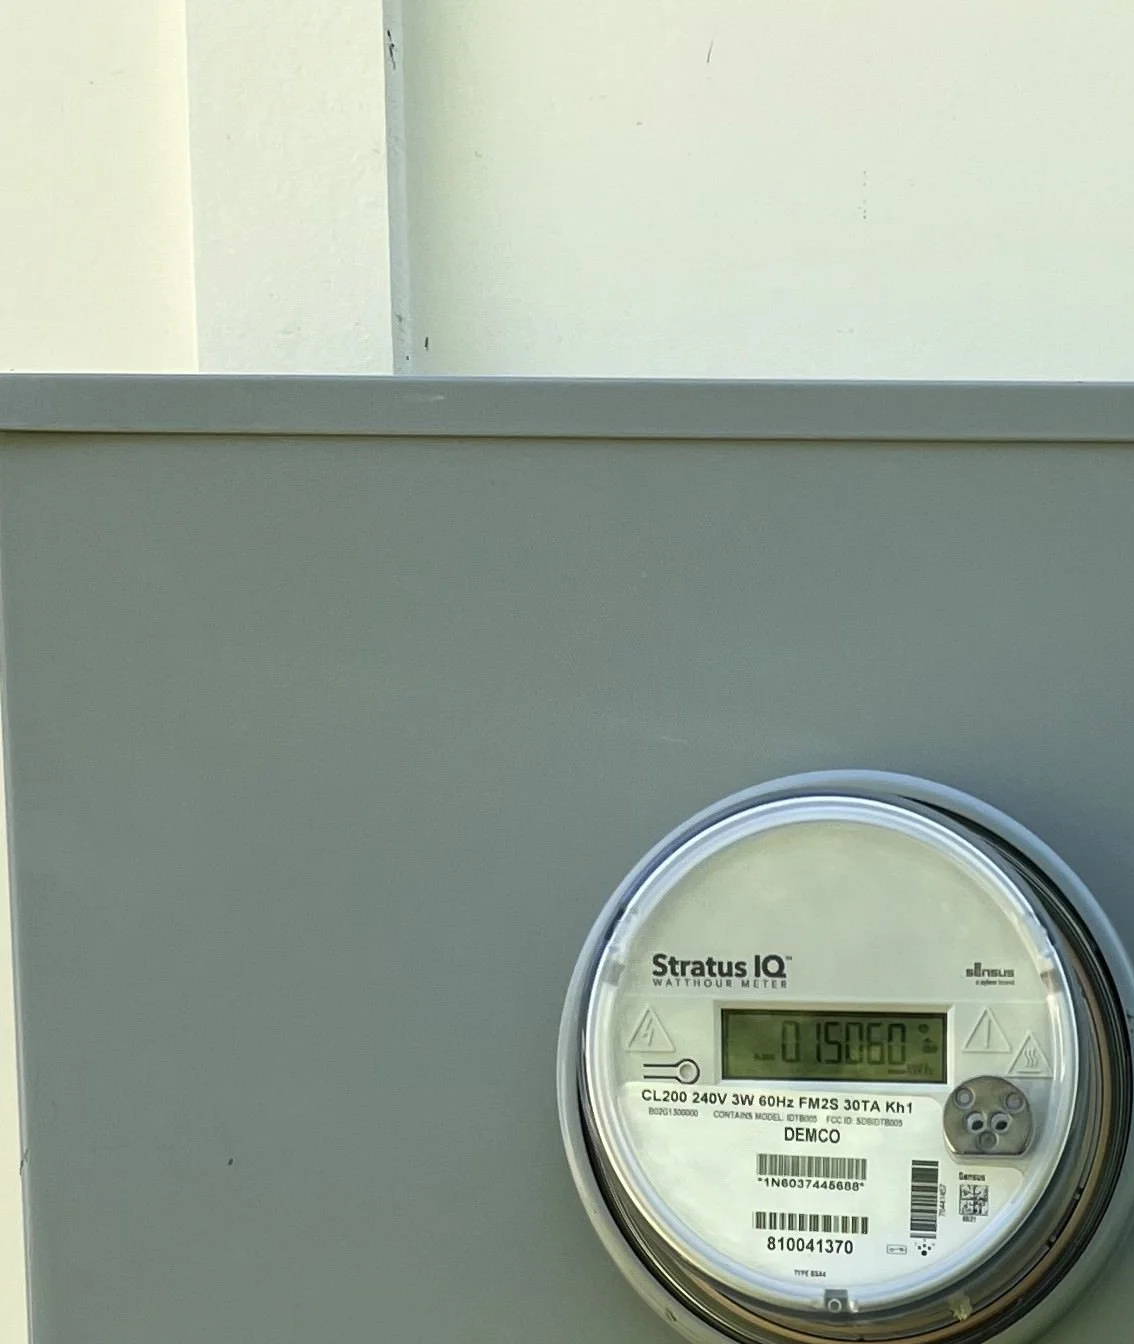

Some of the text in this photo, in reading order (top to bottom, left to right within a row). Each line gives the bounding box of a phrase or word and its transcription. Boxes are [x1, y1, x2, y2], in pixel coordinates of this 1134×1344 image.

[652, 953, 747, 978] Stratus
[652, 978, 787, 988] WATTHOUR METER
[642, 1089, 912, 1114] CL200 240V 3W 60Hz FM2S 30TA Kh1
[784, 1126, 840, 1144] DEMCO
[766, 1236, 854, 1254] 810041370
